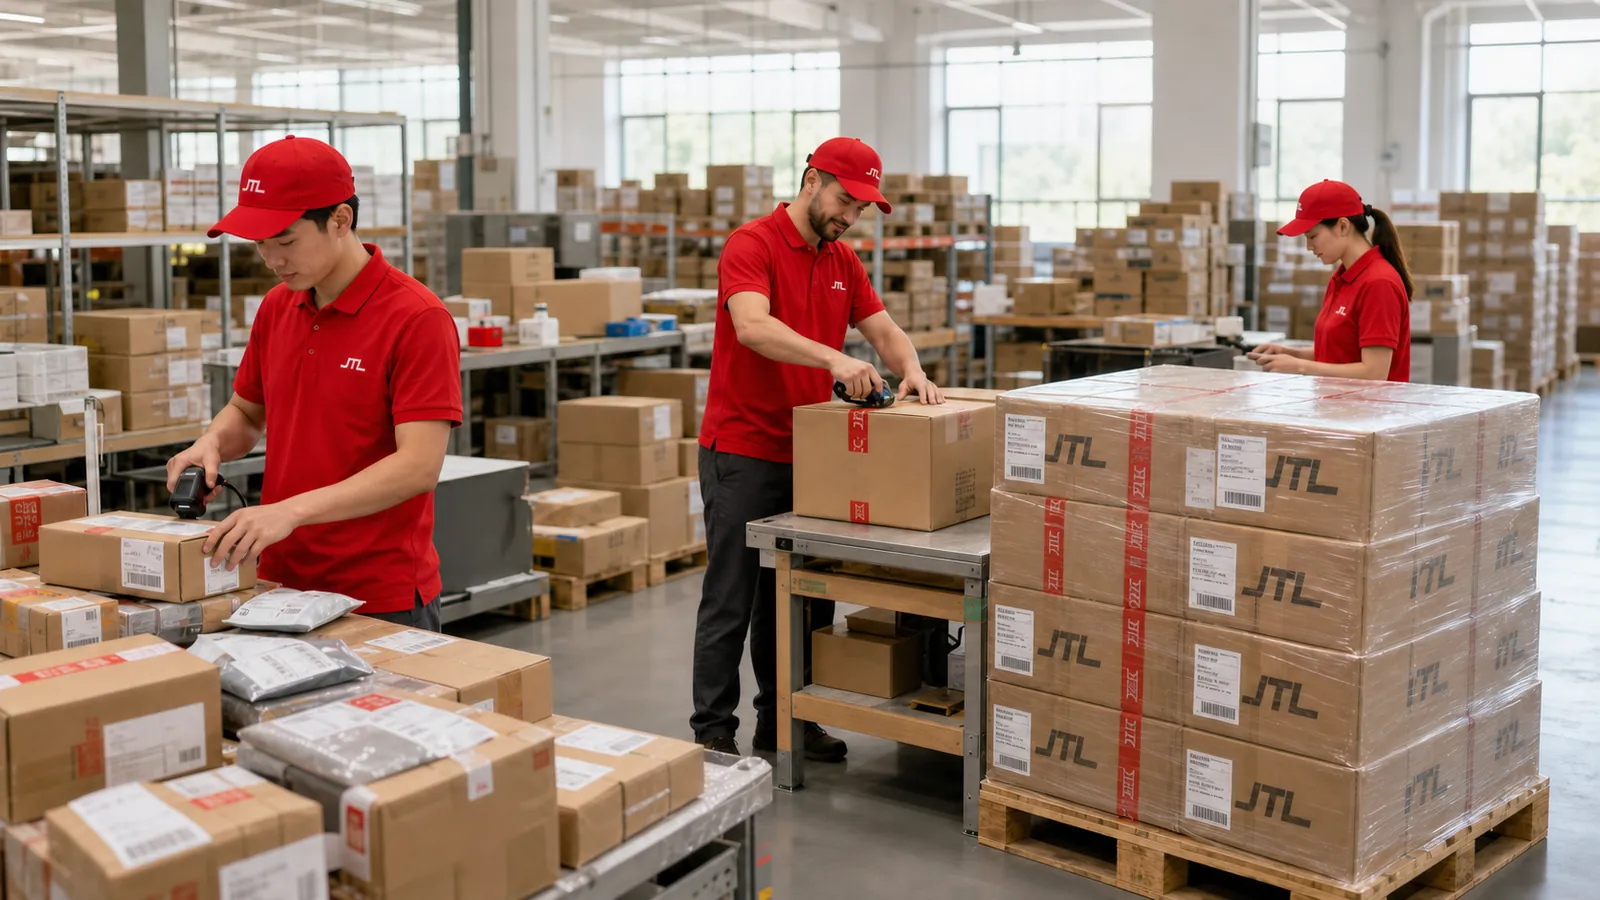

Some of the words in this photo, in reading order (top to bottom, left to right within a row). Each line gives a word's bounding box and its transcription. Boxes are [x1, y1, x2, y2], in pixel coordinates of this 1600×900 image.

[242, 179, 265, 193] JTL
[831, 281, 846, 290] JTL
[340, 357, 366, 371] JTL
[1045, 434, 1107, 469] JTL
[1265, 455, 1338, 496] JTL
[1242, 565, 1322, 609] JTL
[1037, 629, 1101, 668] JTL
[1241, 675, 1318, 720] JTL
[1035, 729, 1098, 769] JTL
[1235, 782, 1312, 829] JTL
